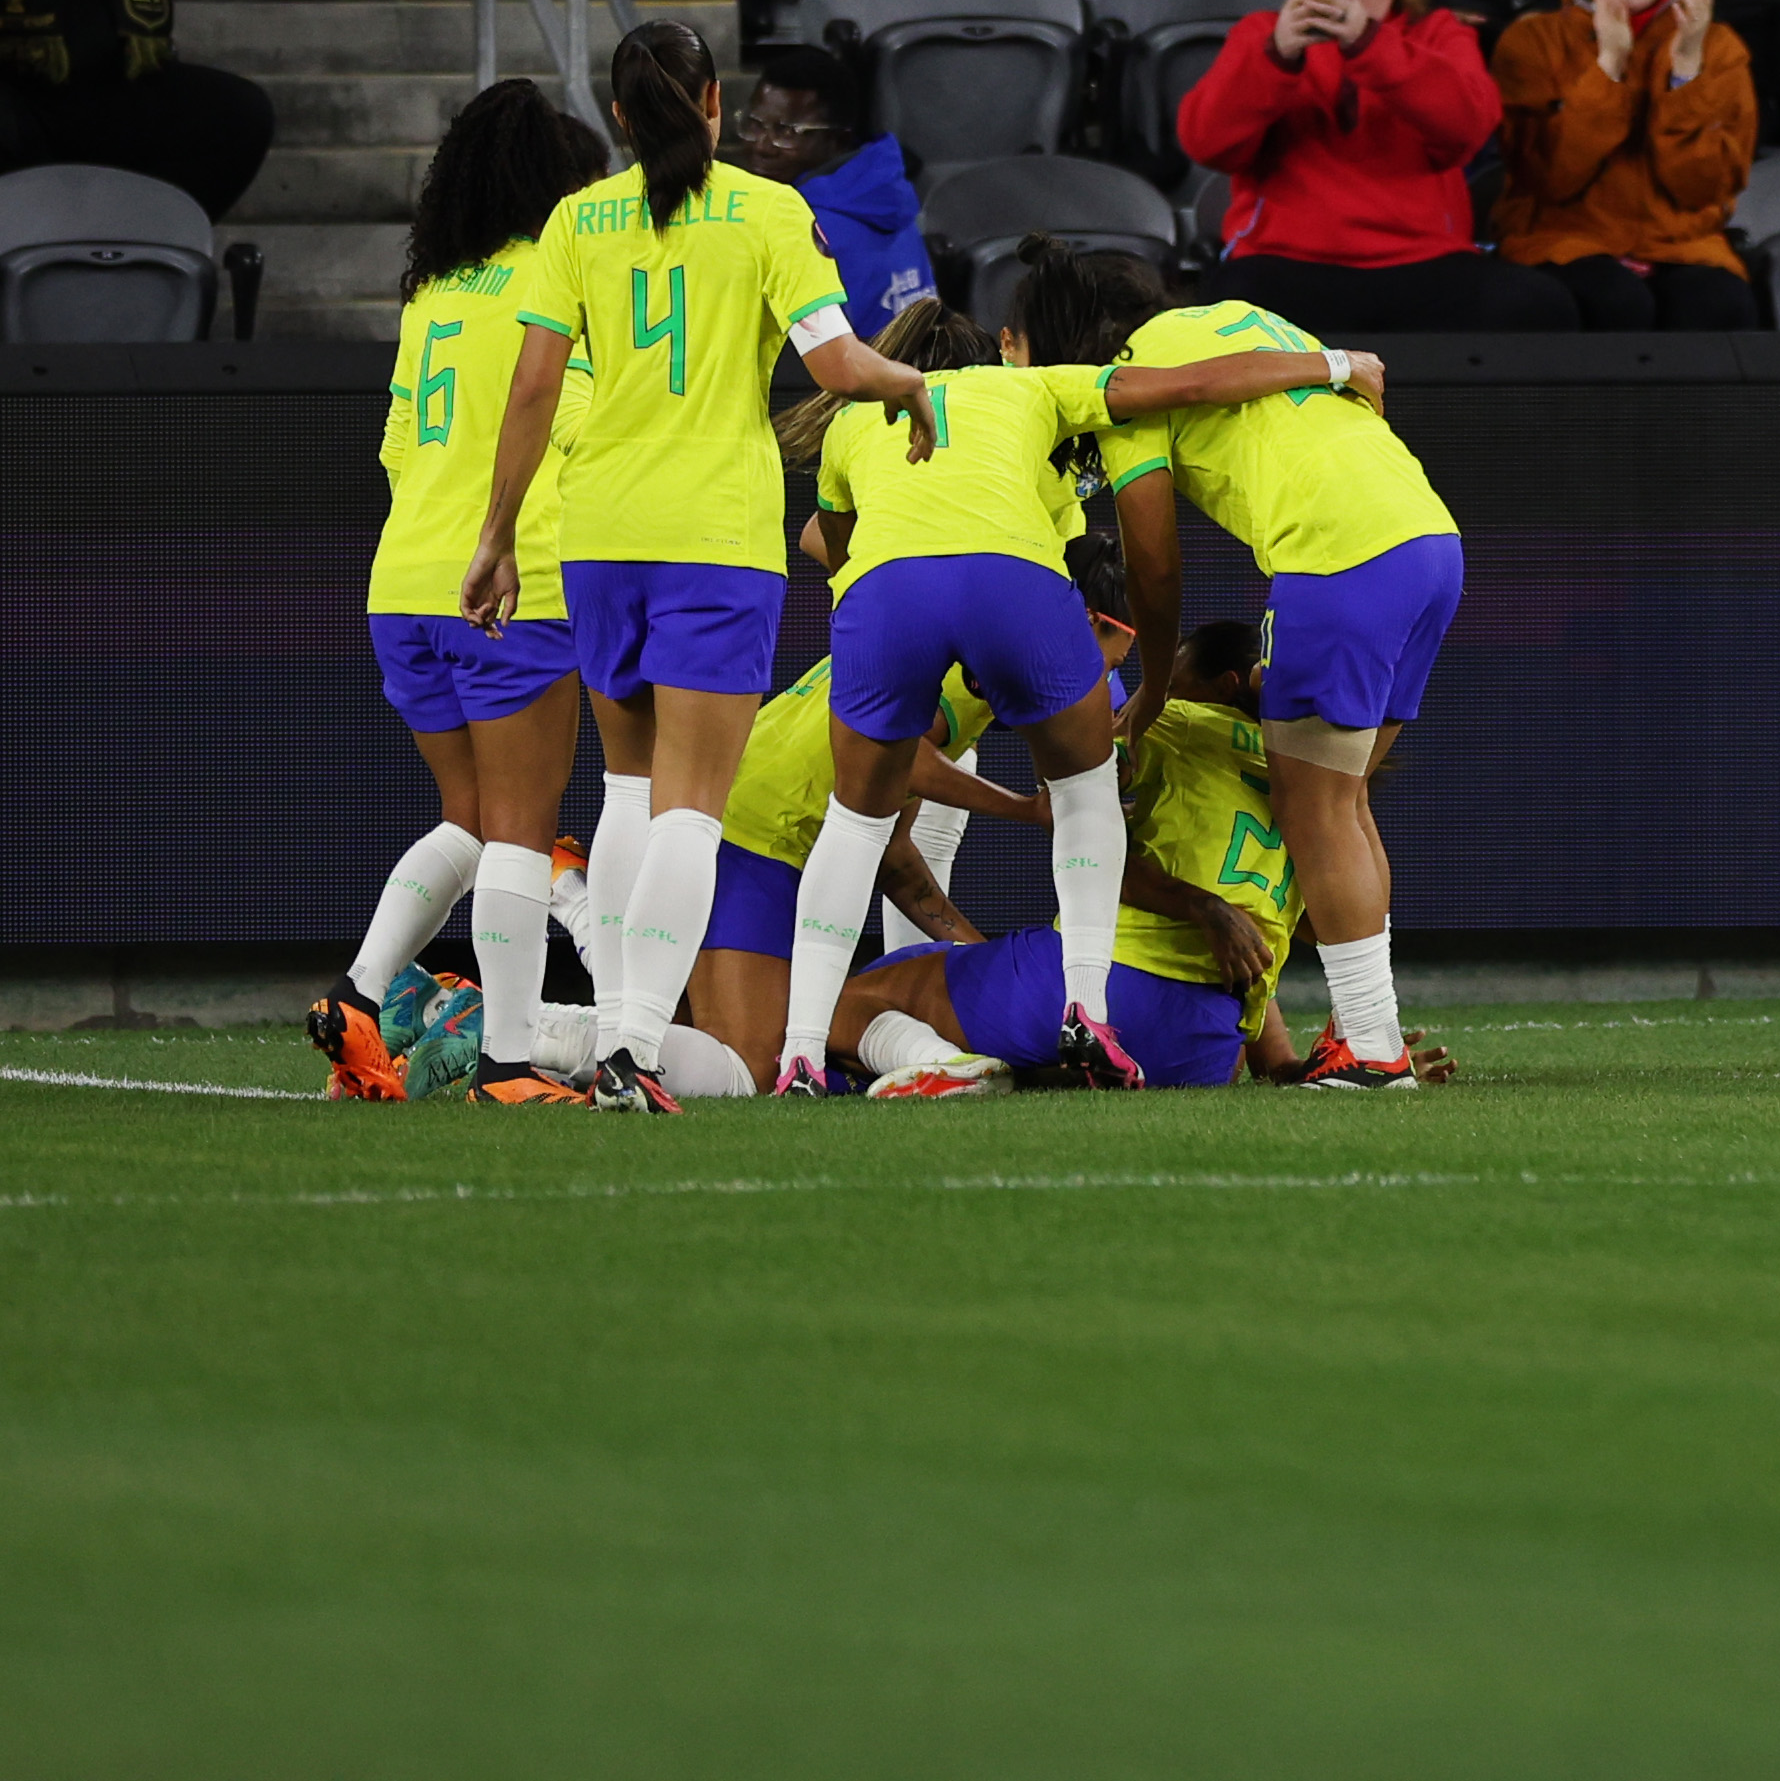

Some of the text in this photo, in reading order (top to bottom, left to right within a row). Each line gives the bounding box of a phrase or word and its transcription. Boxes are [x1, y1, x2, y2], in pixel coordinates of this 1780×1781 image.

[576, 189, 749, 237] RAFLLE
[418, 319, 464, 448] 6
[631, 264, 685, 397] 4
